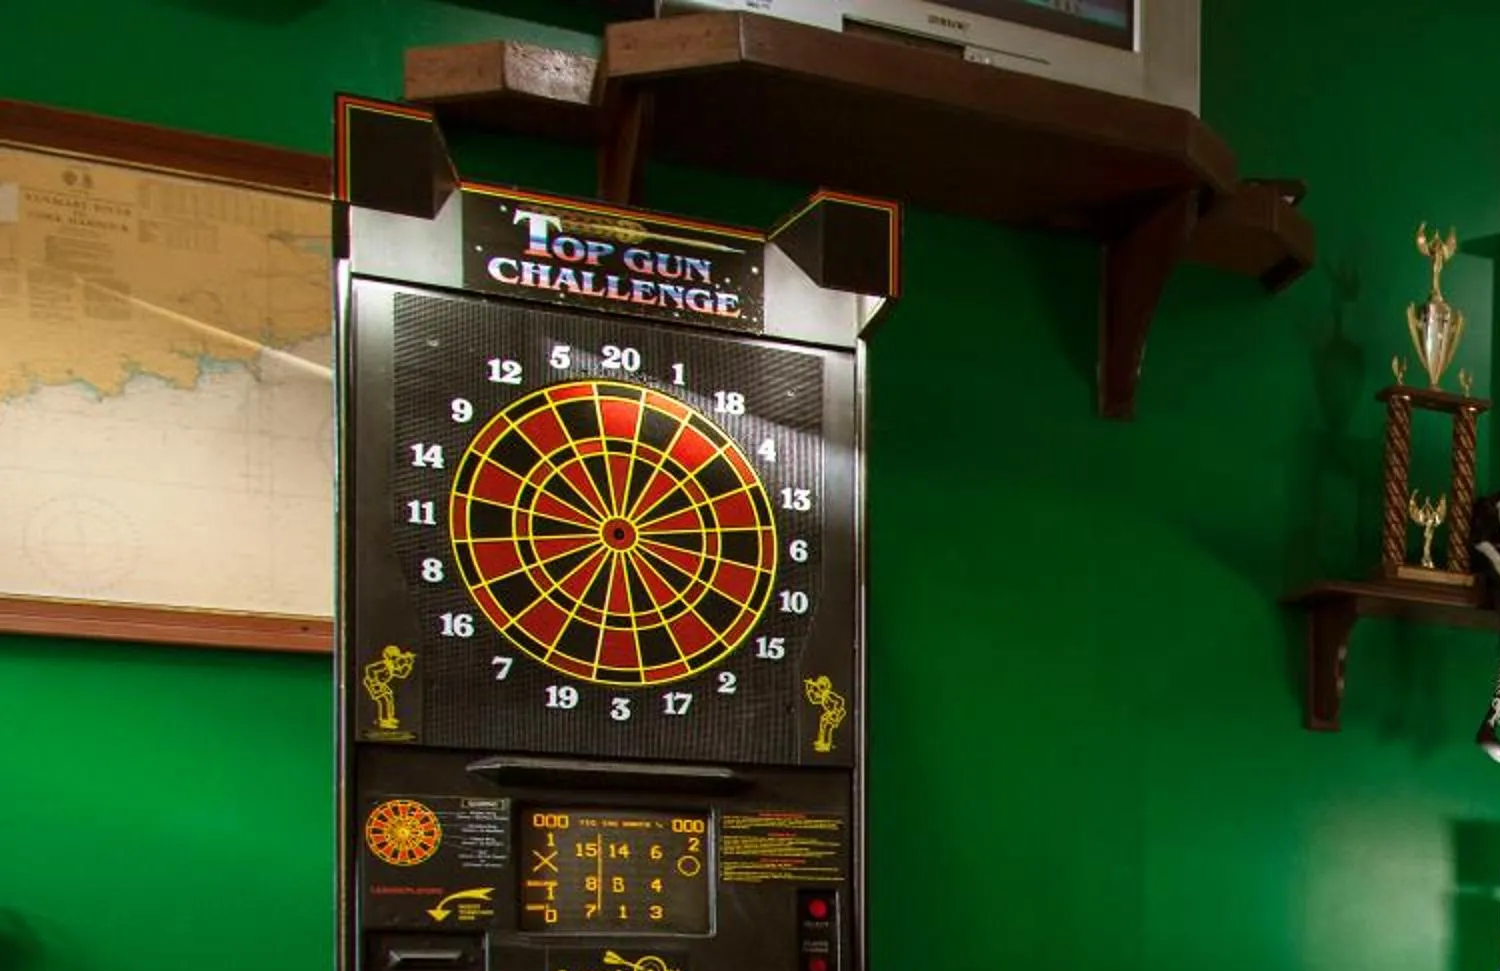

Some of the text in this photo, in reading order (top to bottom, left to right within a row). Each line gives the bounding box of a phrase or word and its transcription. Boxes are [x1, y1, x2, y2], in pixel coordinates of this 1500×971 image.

[513, 207, 713, 284] TOP GUN
[487, 256, 743, 318] CHALLENGE
[549, 346, 571, 369] 5
[601, 346, 641, 371] 20
[488, 358, 522, 384] 12
[672, 363, 685, 385] 1
[452, 398, 473, 422] 9
[713, 391, 745, 416] 18
[411, 443, 444, 468] 14
[757, 440, 777, 462] 4
[780, 488, 810, 512] 13
[408, 500, 436, 524] 11
[790, 540, 807, 562] 6
[422, 558, 443, 582] 8
[780, 590, 808, 613] 10
[440, 613, 474, 637] 16
[756, 637, 784, 659] 15
[492, 656, 512, 679] 7
[718, 672, 736, 693] 2
[546, 686, 578, 708] 19
[663, 692, 692, 714] 17
[611, 698, 630, 720] 3
[671, 819, 705, 833] 000
[547, 831, 555, 847] 1
[575, 843, 598, 857] 15
[688, 837, 700, 852] 2
[609, 843, 630, 858] 14
[651, 845, 663, 860] 6
[585, 876, 597, 891] 8
[651, 878, 663, 893] 4
[584, 904, 597, 918] 7
[619, 904, 628, 919] 1
[650, 905, 663, 919] 3
